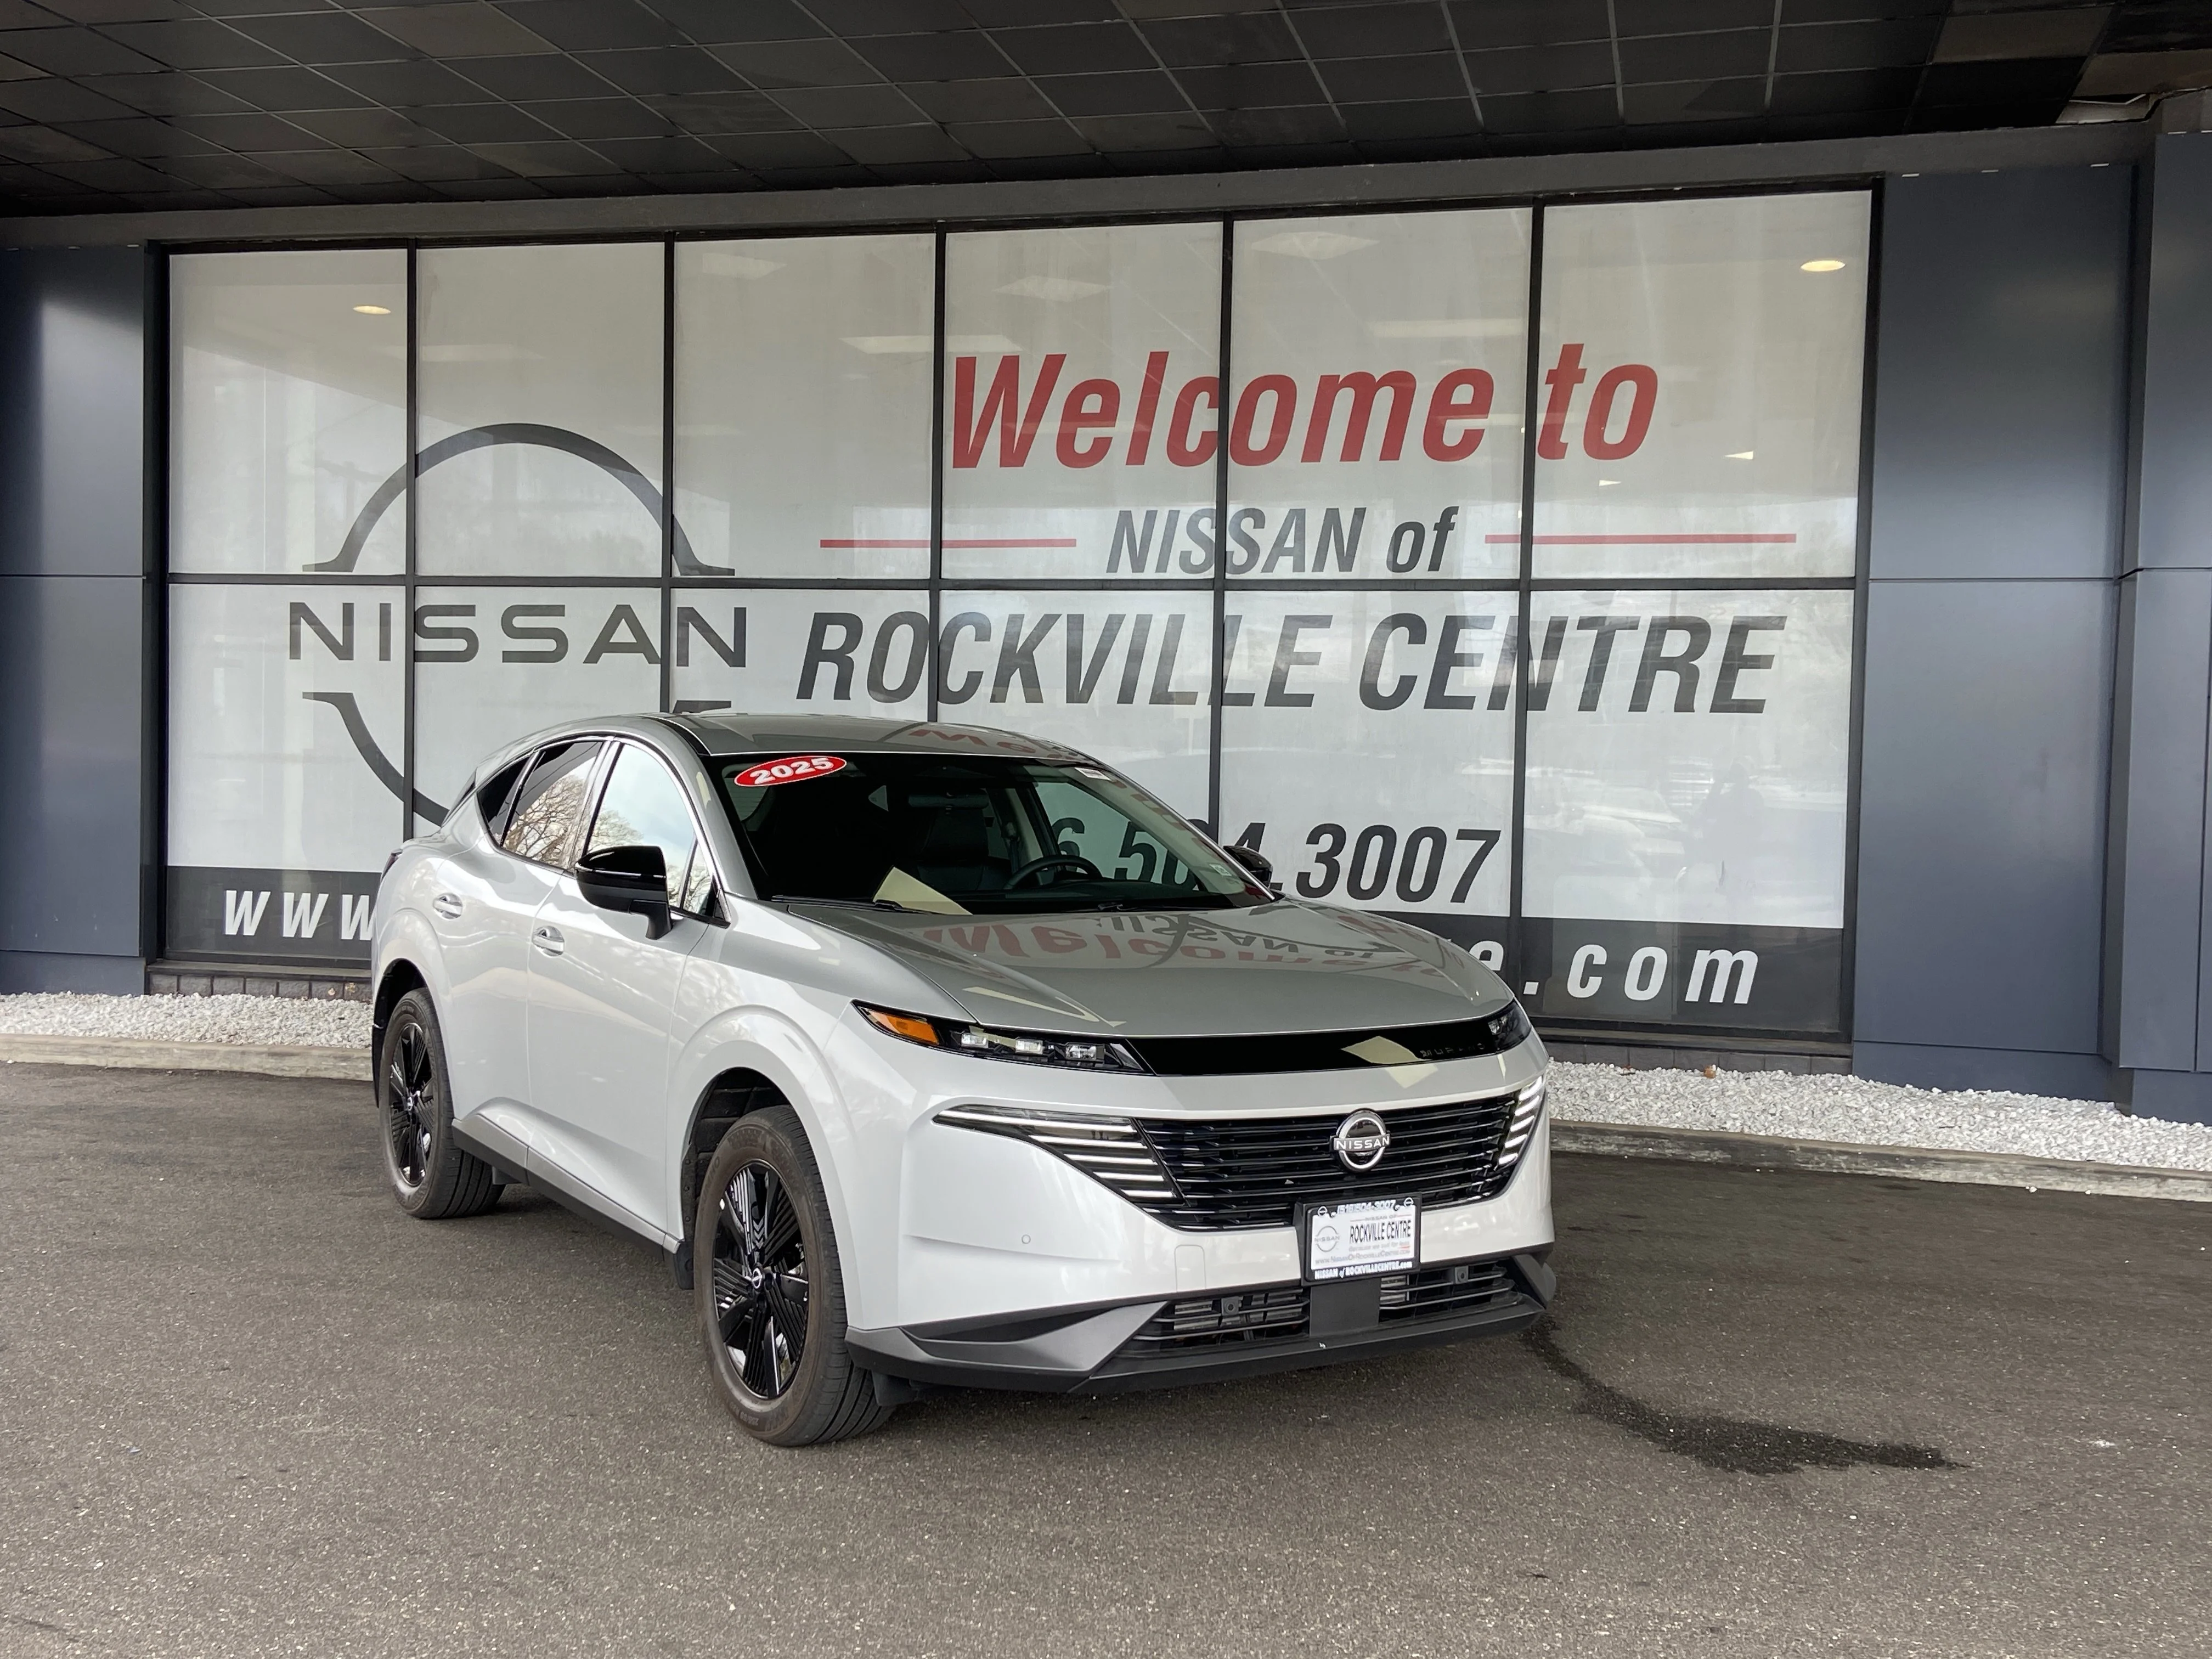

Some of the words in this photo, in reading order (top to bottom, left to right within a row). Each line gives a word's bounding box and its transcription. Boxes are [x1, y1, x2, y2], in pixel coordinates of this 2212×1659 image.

[952, 352, 1493, 469] Welcome
[1537, 343, 1659, 460] to
[1106, 507, 1367, 574] NISSAN
[1385, 506, 1459, 574] of
[289, 602, 747, 668] NISSAN
[797, 611, 1334, 708] ROCKVILLE
[1360, 613, 1786, 714] CENTRE
[749, 757, 834, 785] 2025
[1336, 1137, 1390, 1150] NISSAN
[1349, 1222, 1385, 1244] ROCKVILLE
[1386, 1220, 1412, 1239] CENTRE
[1314, 1268, 1339, 1280] NISSAN
